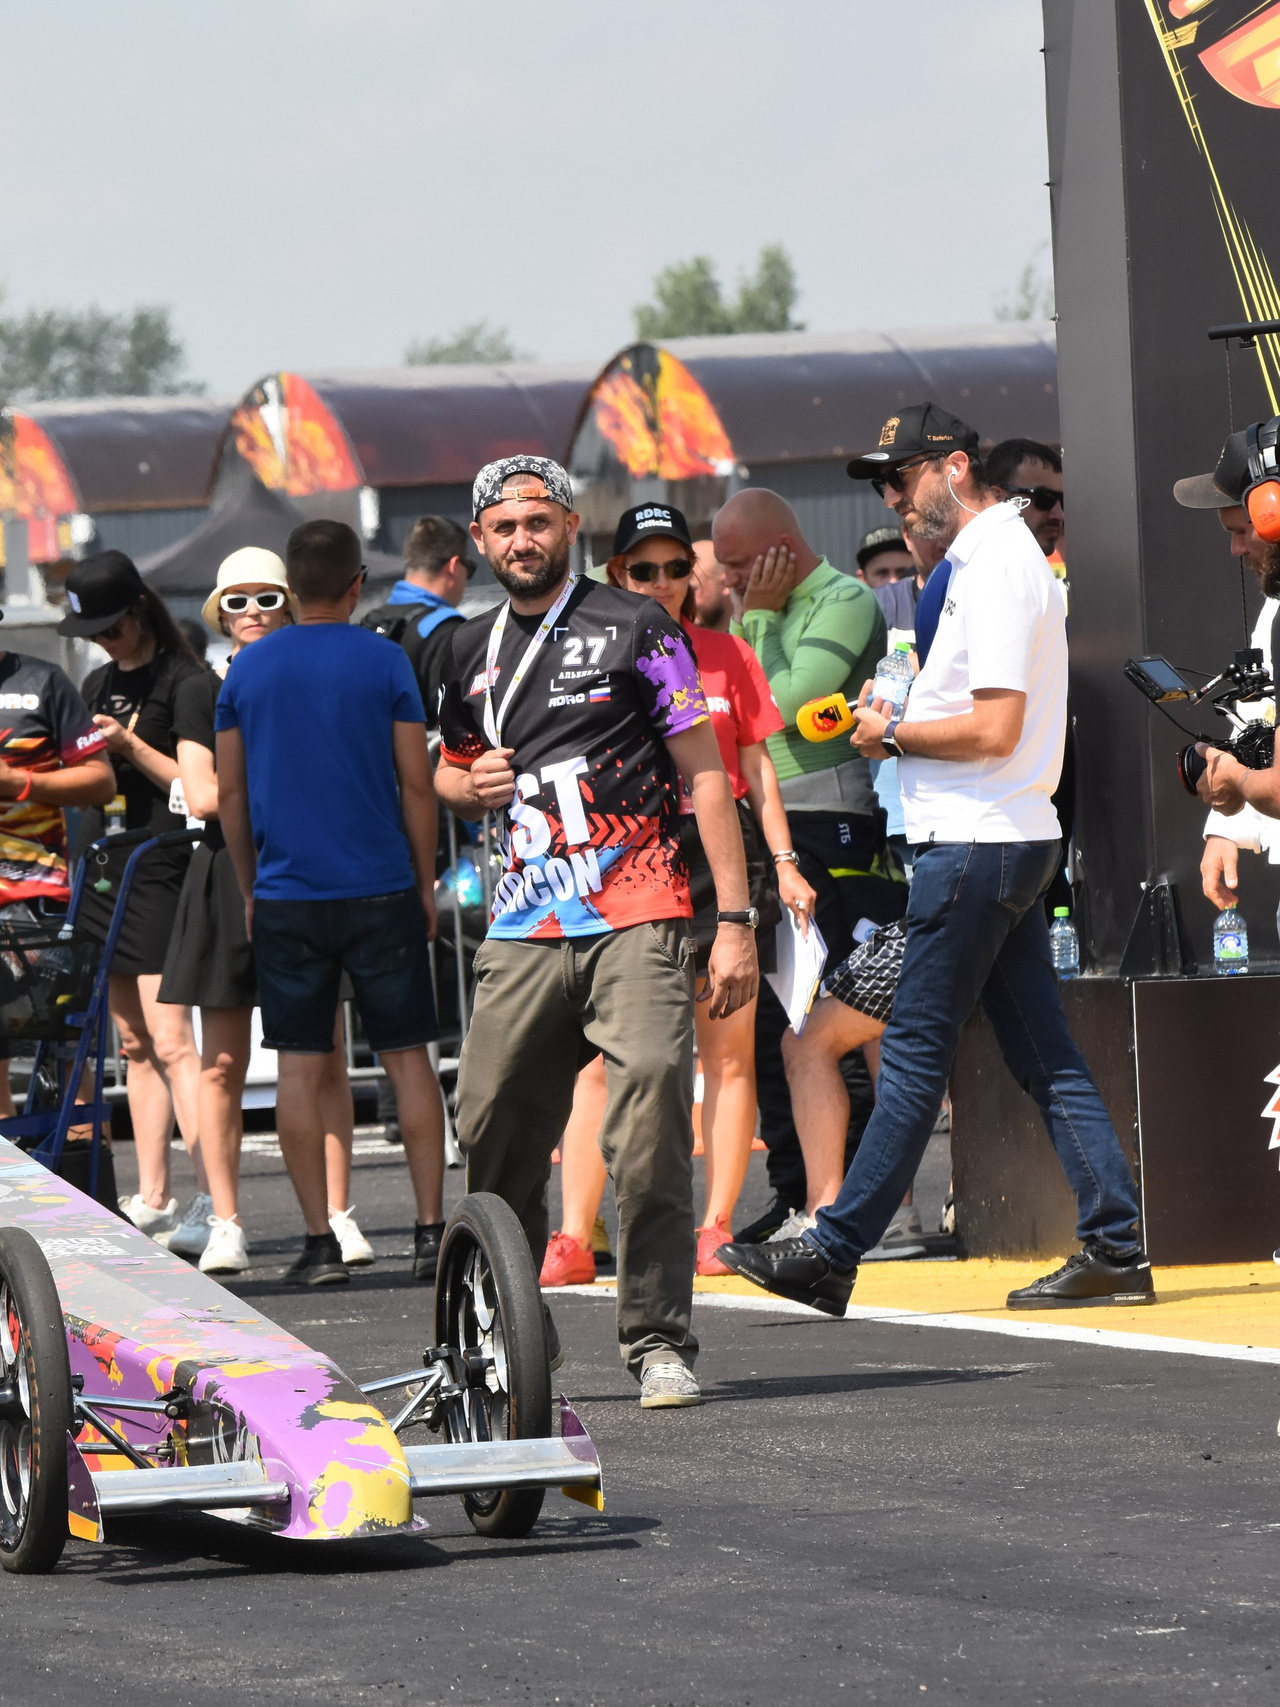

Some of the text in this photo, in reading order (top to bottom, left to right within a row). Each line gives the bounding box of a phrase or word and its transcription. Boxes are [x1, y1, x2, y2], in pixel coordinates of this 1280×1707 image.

[635, 507, 672, 522] RDRC
[637, 519, 673, 530] Official
[562, 636, 608, 667] 27
